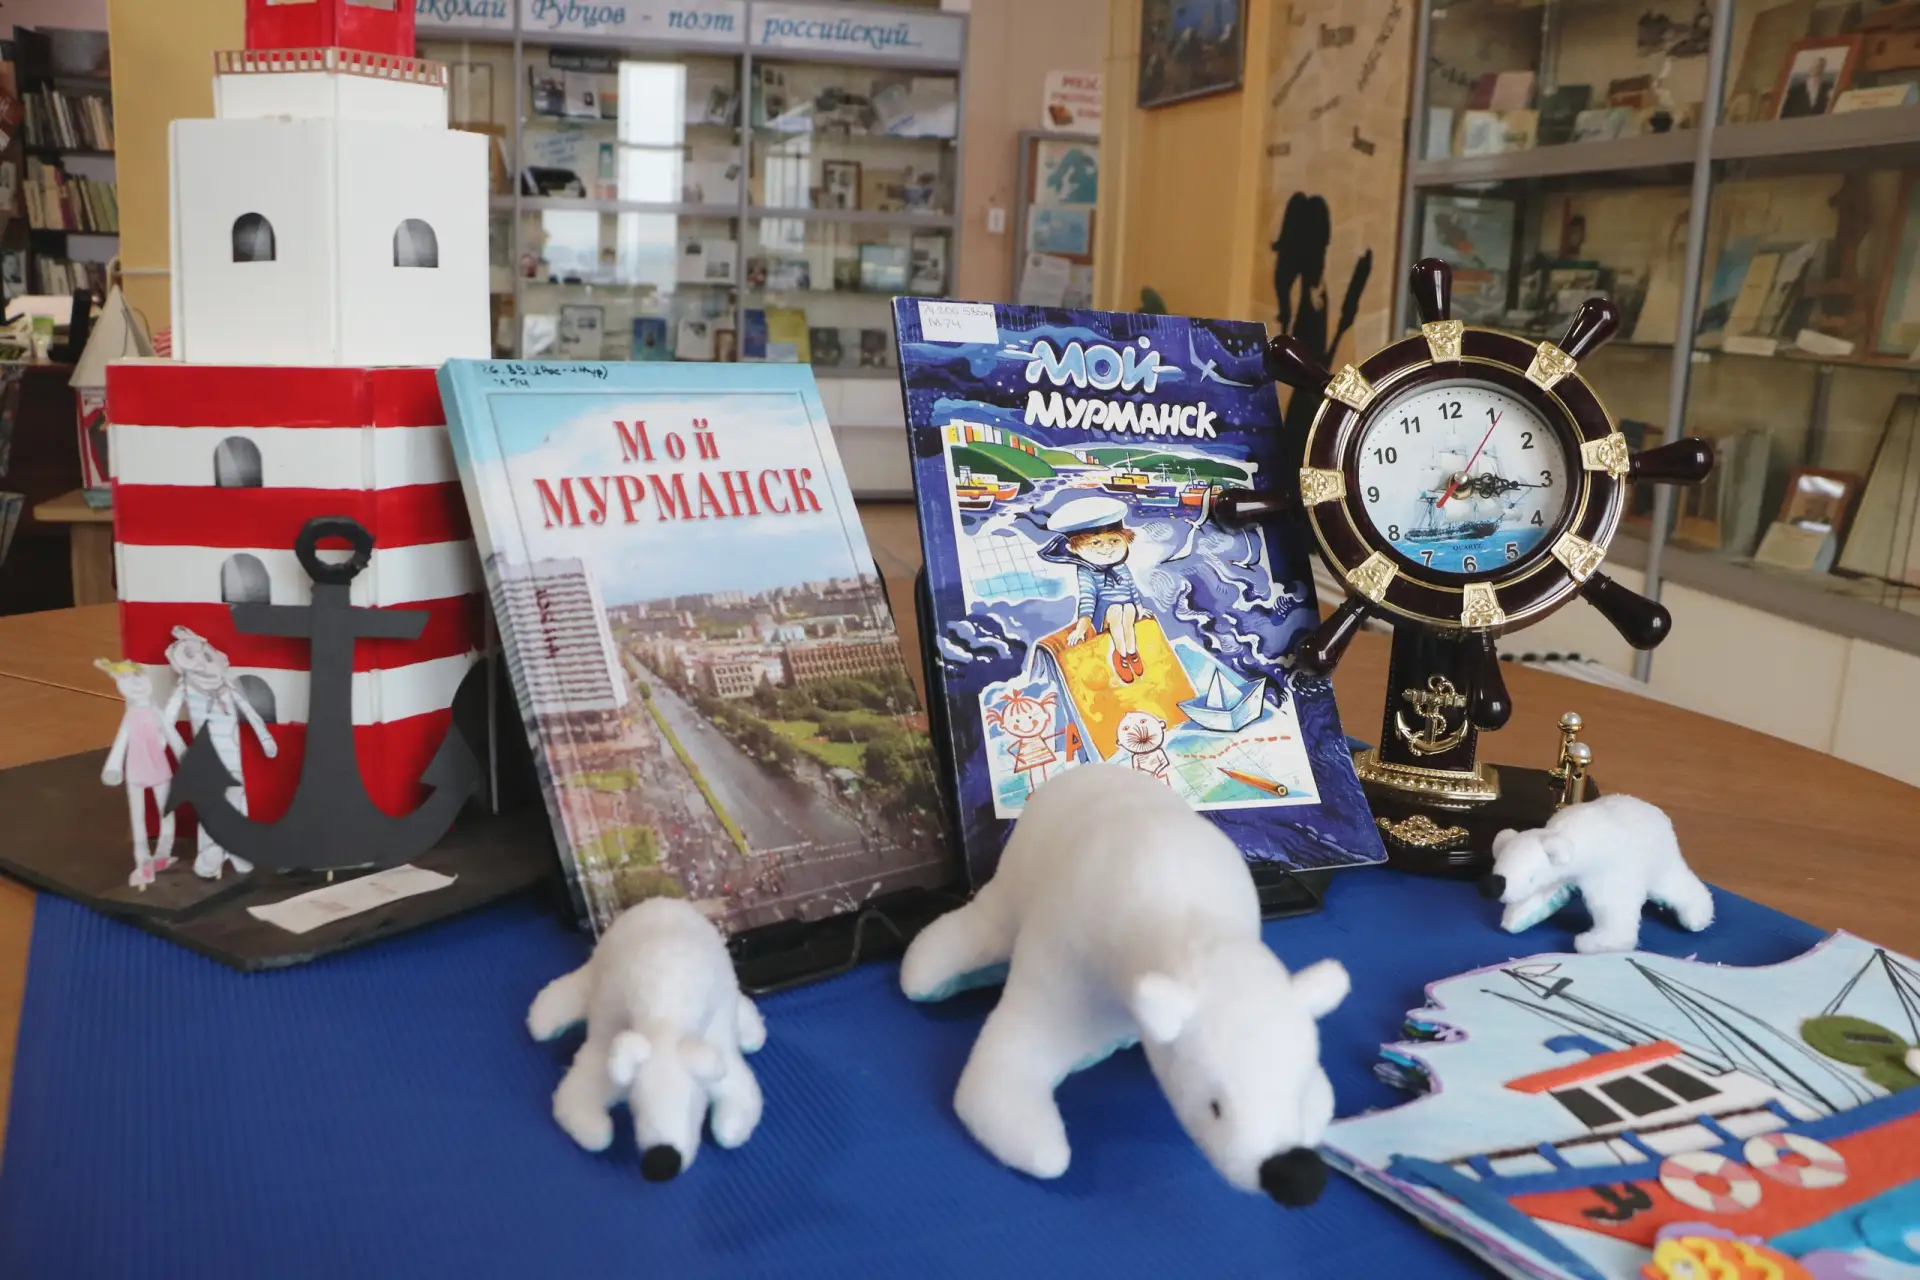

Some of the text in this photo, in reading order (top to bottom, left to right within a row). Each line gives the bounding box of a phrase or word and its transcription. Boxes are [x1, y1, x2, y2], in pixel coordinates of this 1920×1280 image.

[532, 0, 627, 36] Рубцов
[667, 9, 735, 33] поэт
[1437, 401, 1463, 420] 12
[1485, 407, 1497, 425] 1
[1399, 416, 1421, 435] 11
[613, 418, 721, 462] Мой
[1520, 431, 1534, 450] 2
[1373, 446, 1398, 465] 10
[1540, 470, 1554, 488] 3
[531, 467, 824, 529] МУРМАНСК
[1367, 486, 1380, 504] 9
[1530, 510, 1545, 527] 4
[1387, 524, 1401, 542] 8
[1453, 542, 1483, 552] QUARTZ
[1505, 543, 1519, 561] 5
[1420, 550, 1434, 567] 7
[1463, 555, 1477, 573] 6
